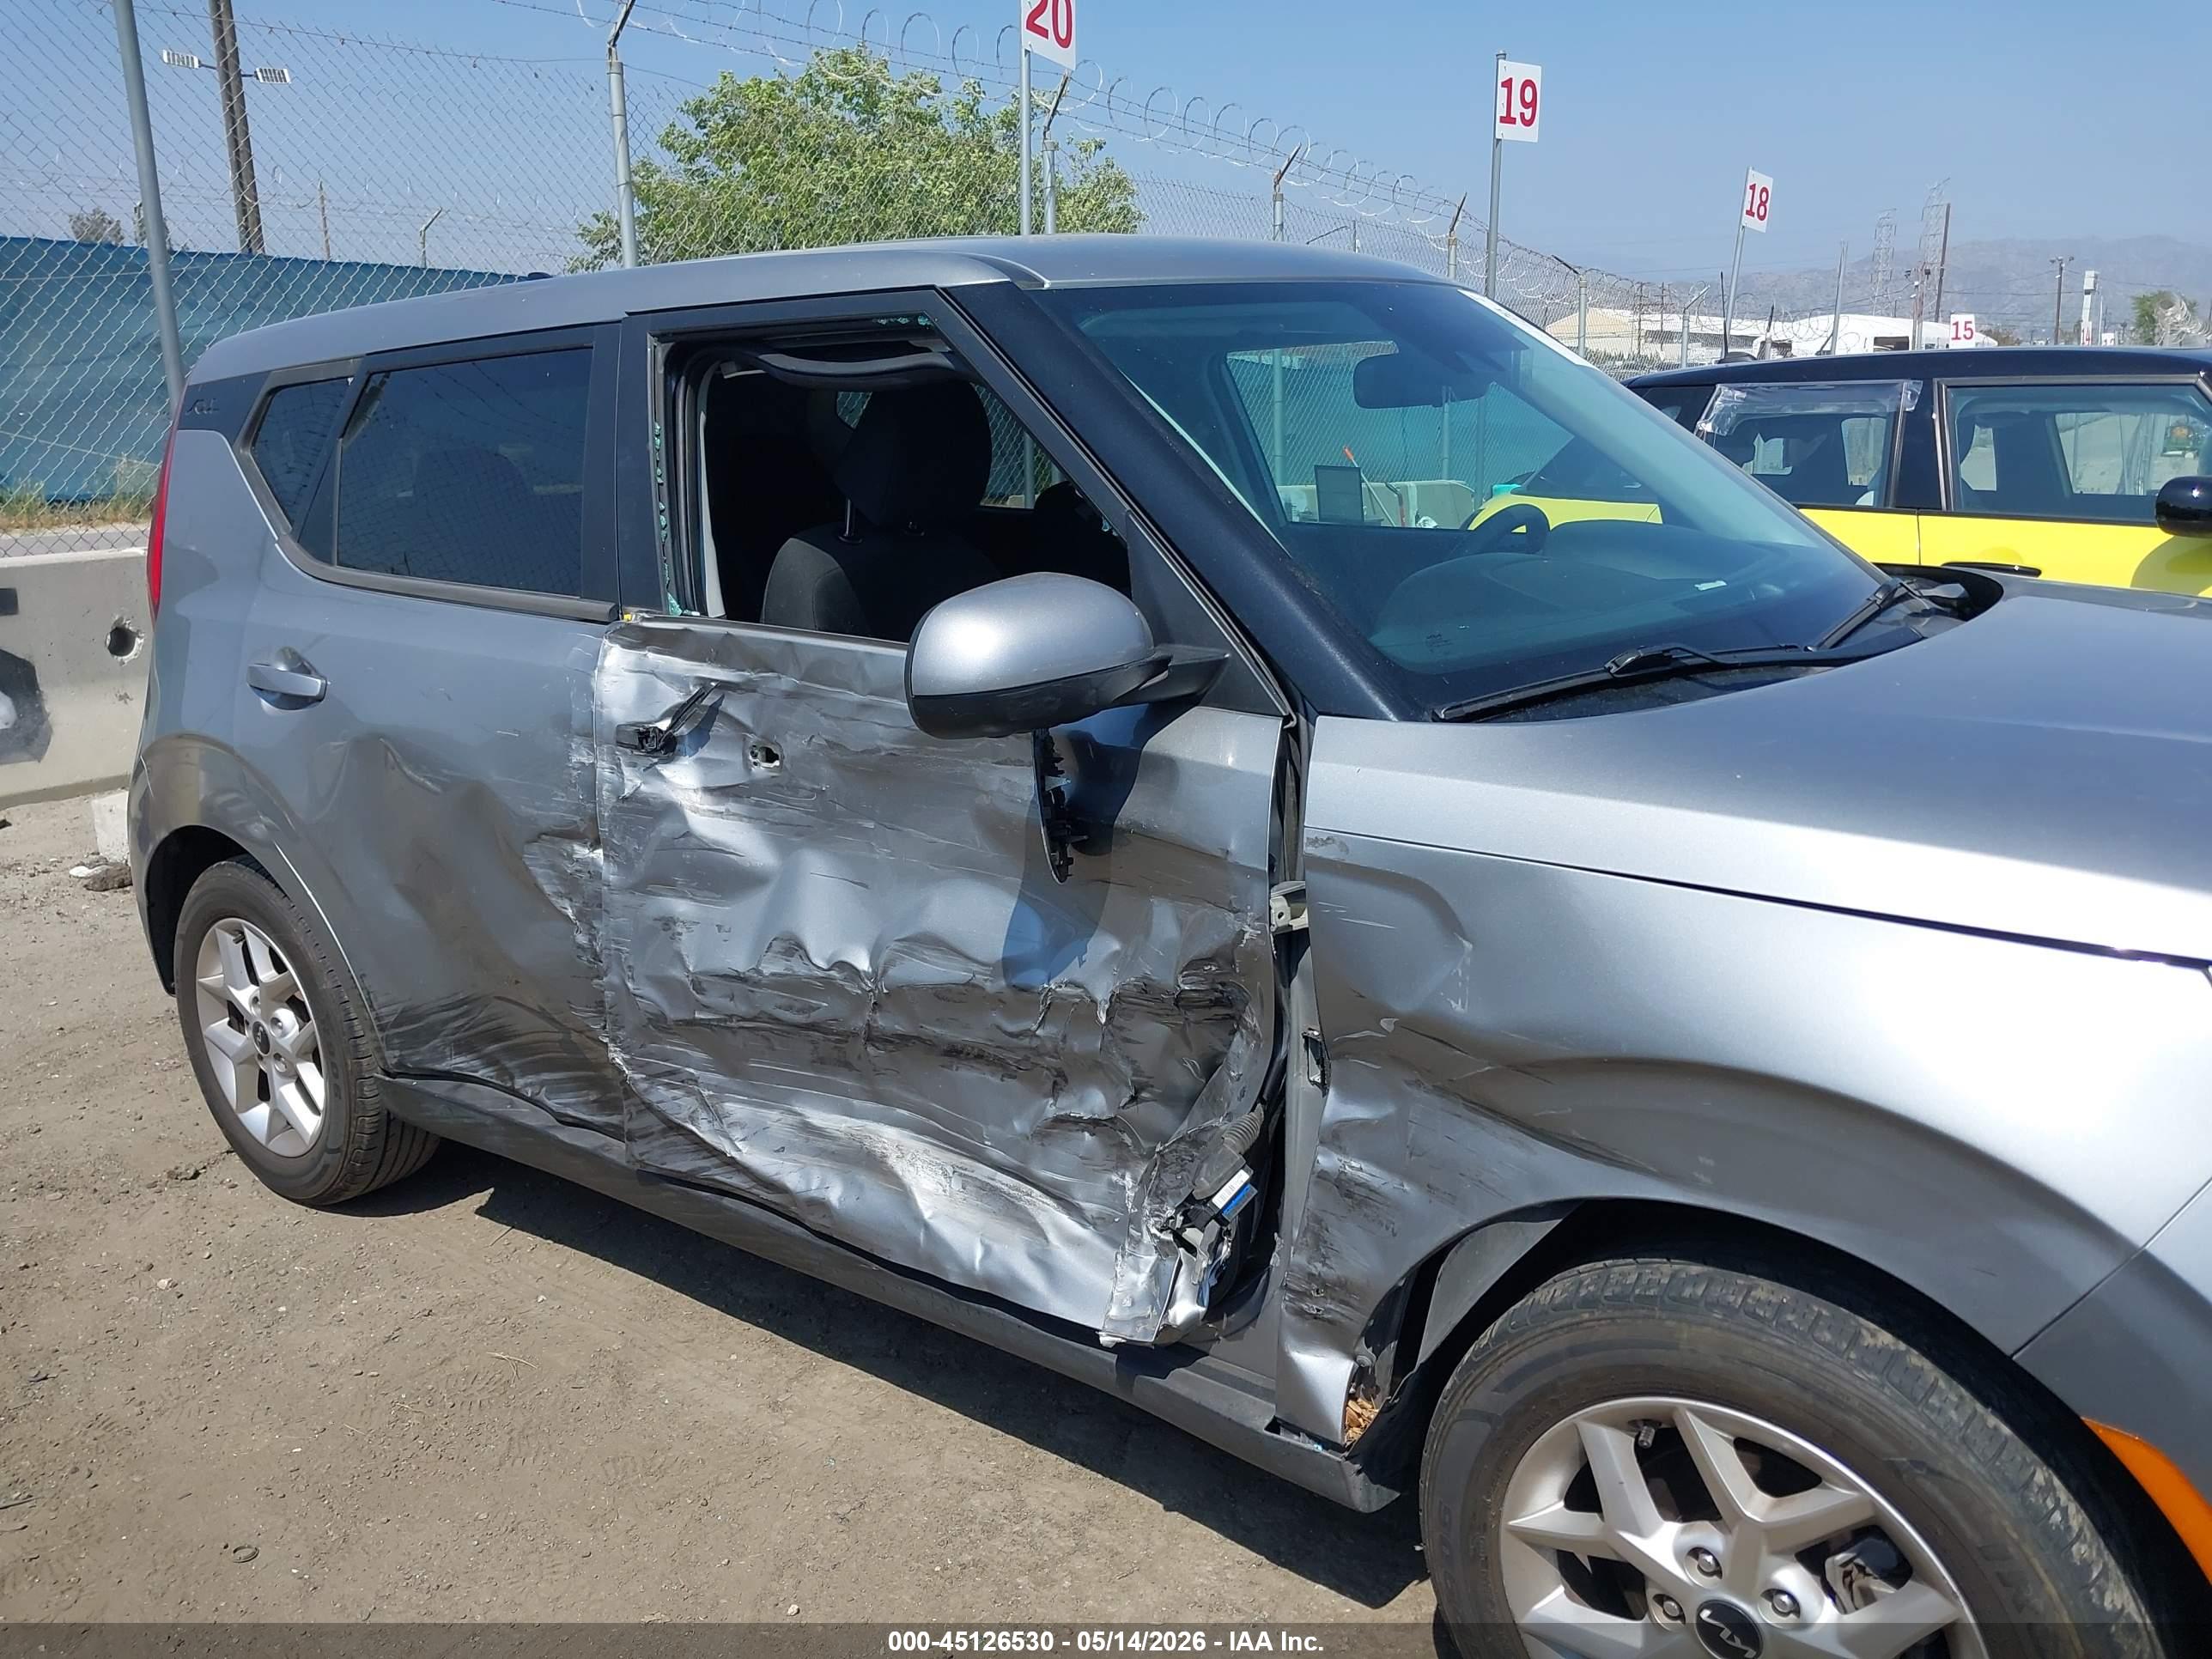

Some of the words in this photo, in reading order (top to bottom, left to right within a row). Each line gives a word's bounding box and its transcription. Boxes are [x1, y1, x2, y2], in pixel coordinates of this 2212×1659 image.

[1026, 0, 1073, 49] 20
[1499, 77, 1537, 127] 19
[1746, 183, 1769, 221] 18
[1951, 321, 1974, 340] 15
[2081, 327, 2091, 344] 14
